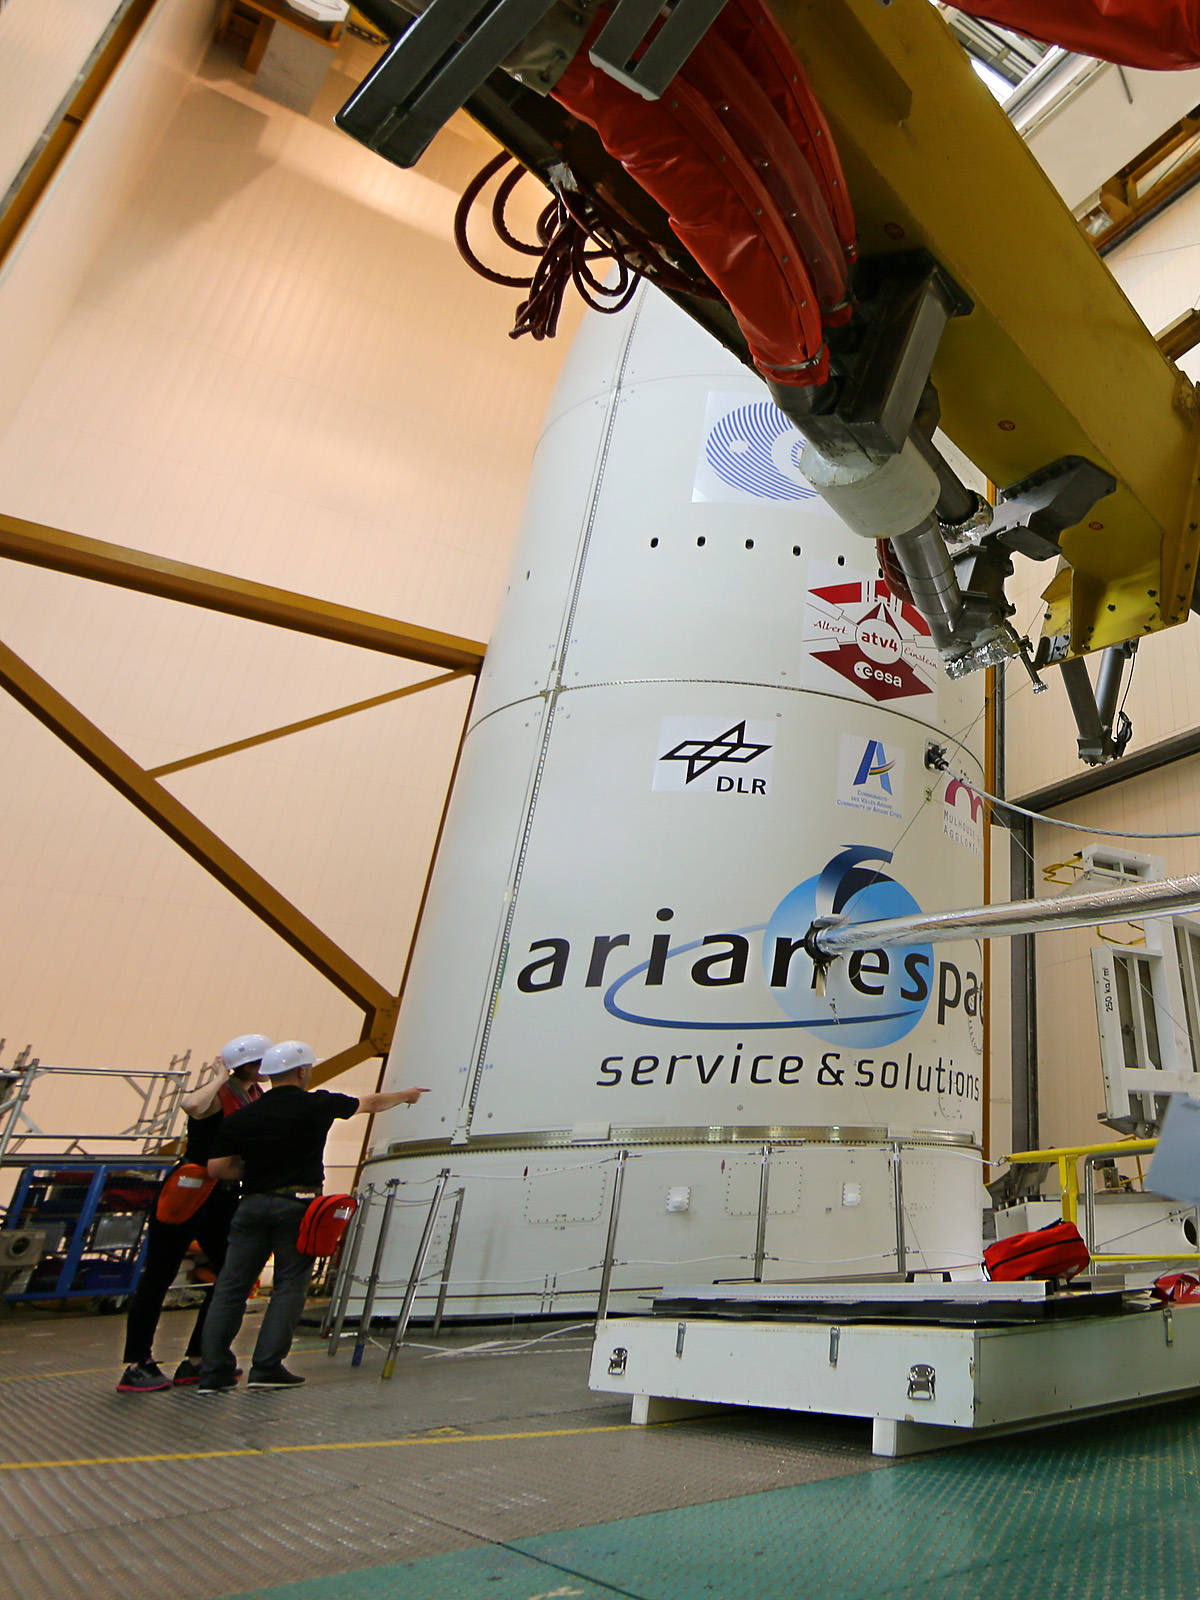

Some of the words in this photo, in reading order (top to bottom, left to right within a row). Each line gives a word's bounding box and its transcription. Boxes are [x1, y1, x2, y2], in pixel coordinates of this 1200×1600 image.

[813, 620, 848, 635] Albert
[861, 631, 898, 652] atv4
[904, 647, 938, 669] Einstein
[716, 775, 767, 795] DLR
[1105, 995, 1114, 1013] 250
[596, 1043, 803, 1087] service
[817, 1052, 845, 1087] &
[854, 1052, 980, 1102] solutions
